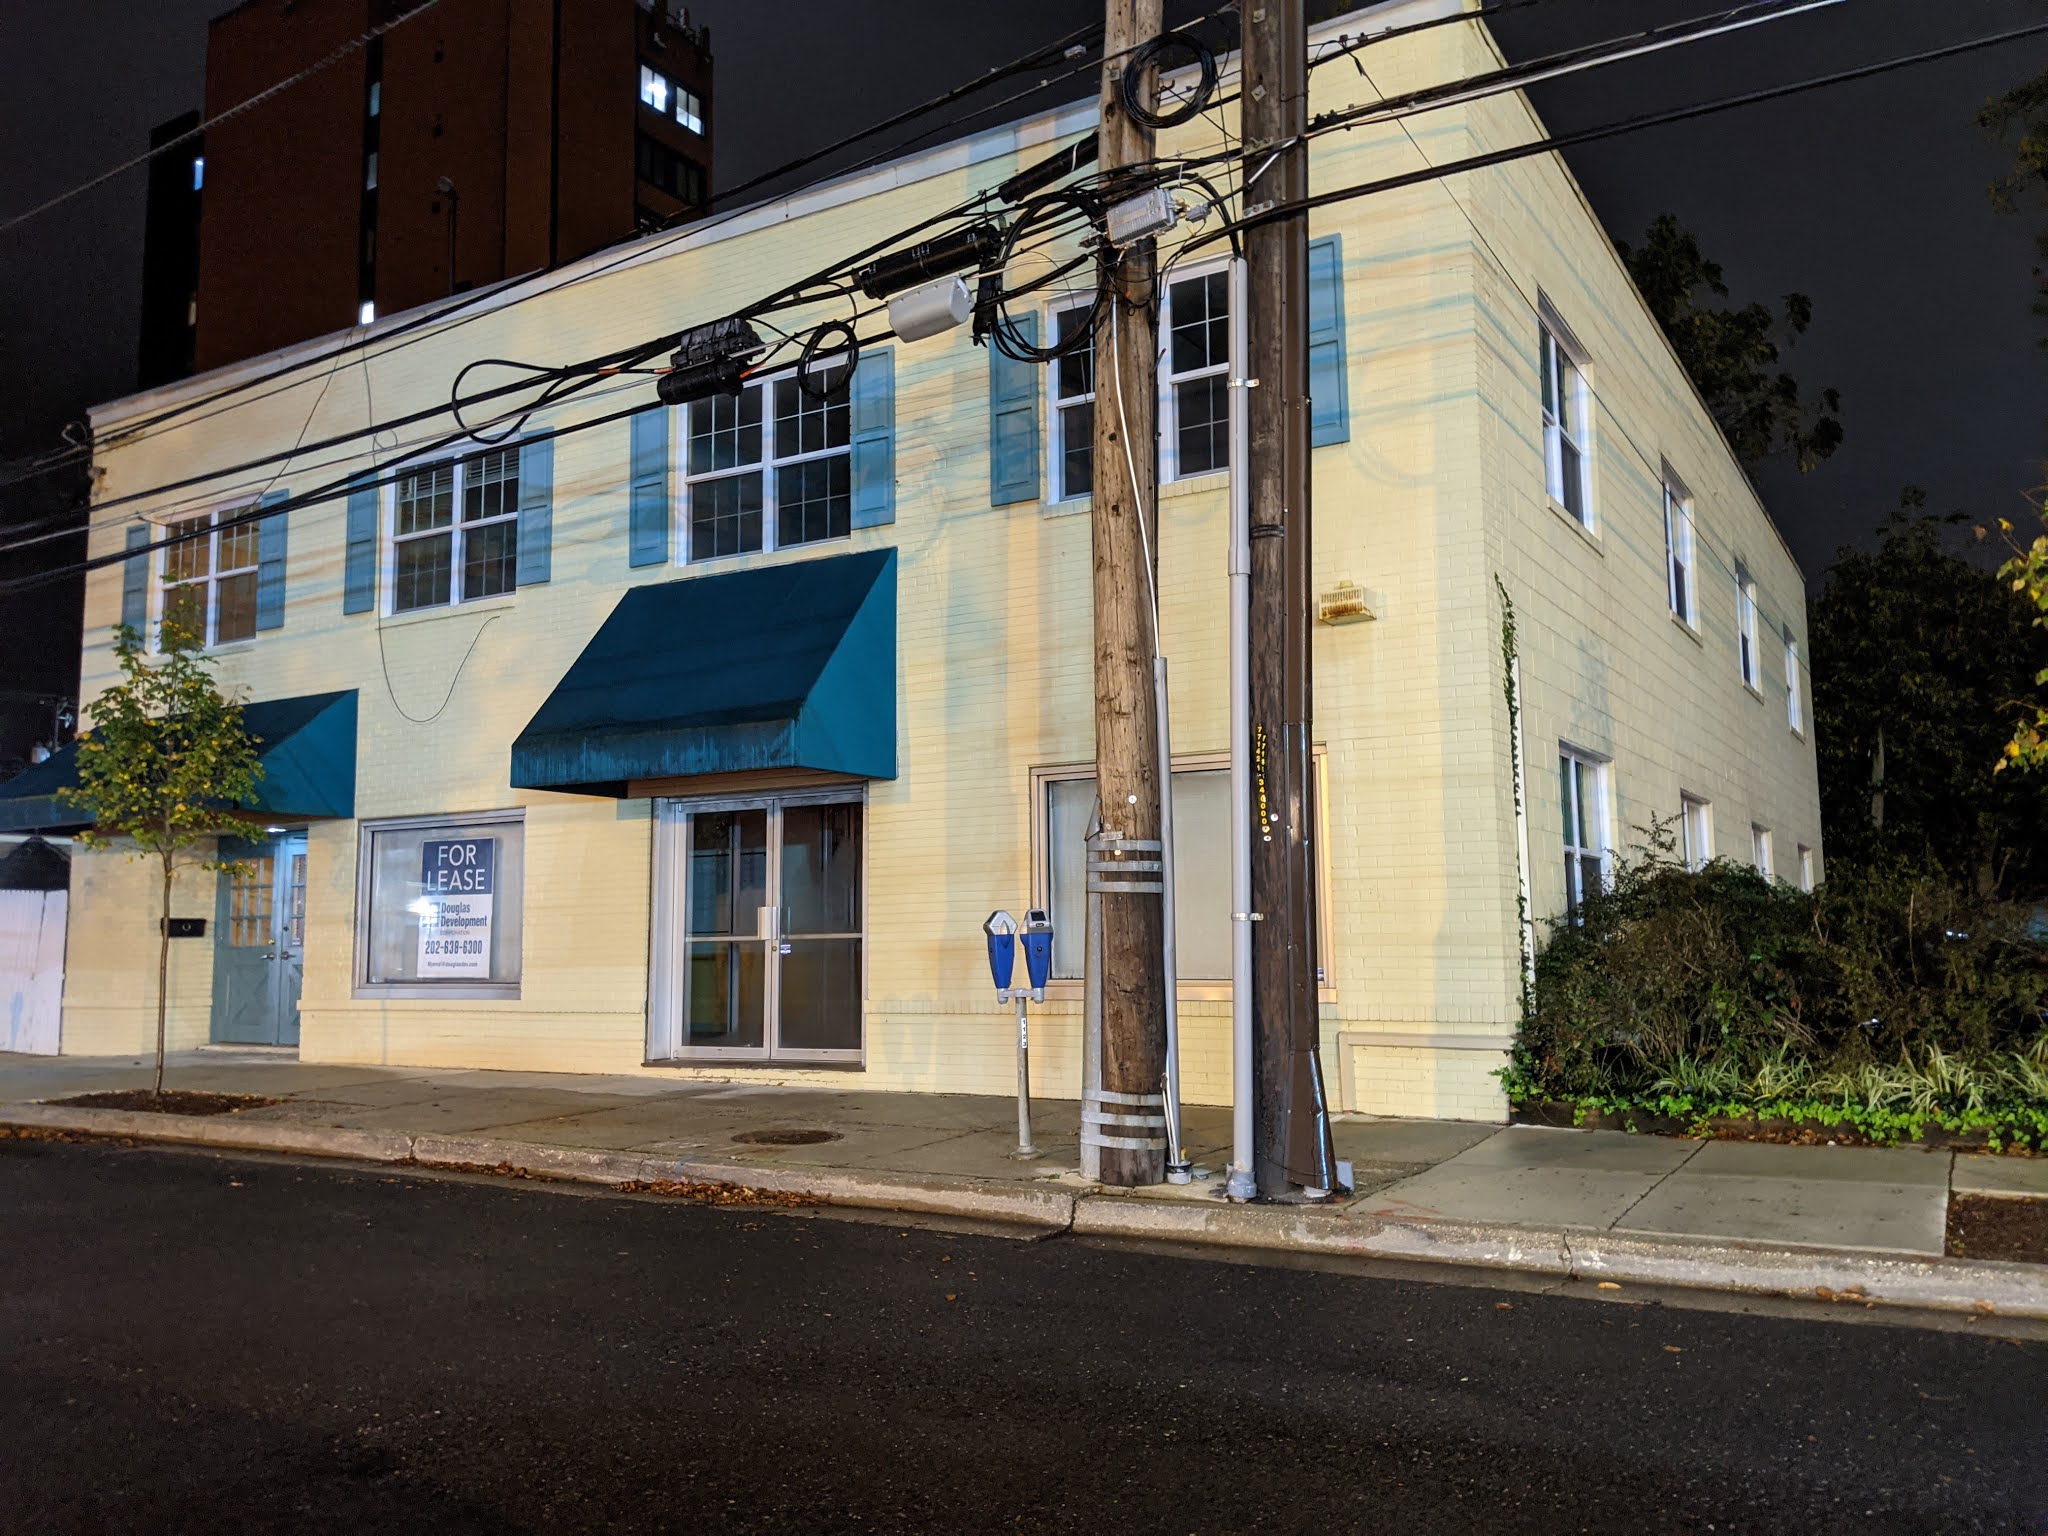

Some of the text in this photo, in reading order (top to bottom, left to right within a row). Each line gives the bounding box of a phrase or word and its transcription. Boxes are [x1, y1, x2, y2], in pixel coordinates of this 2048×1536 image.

[438, 845, 477, 866] FOR
[427, 869, 486, 891] LEASE
[441, 902, 471, 915] Douglas
[440, 915, 487, 929] Development
[425, 940, 483, 955] 202-638-6300
